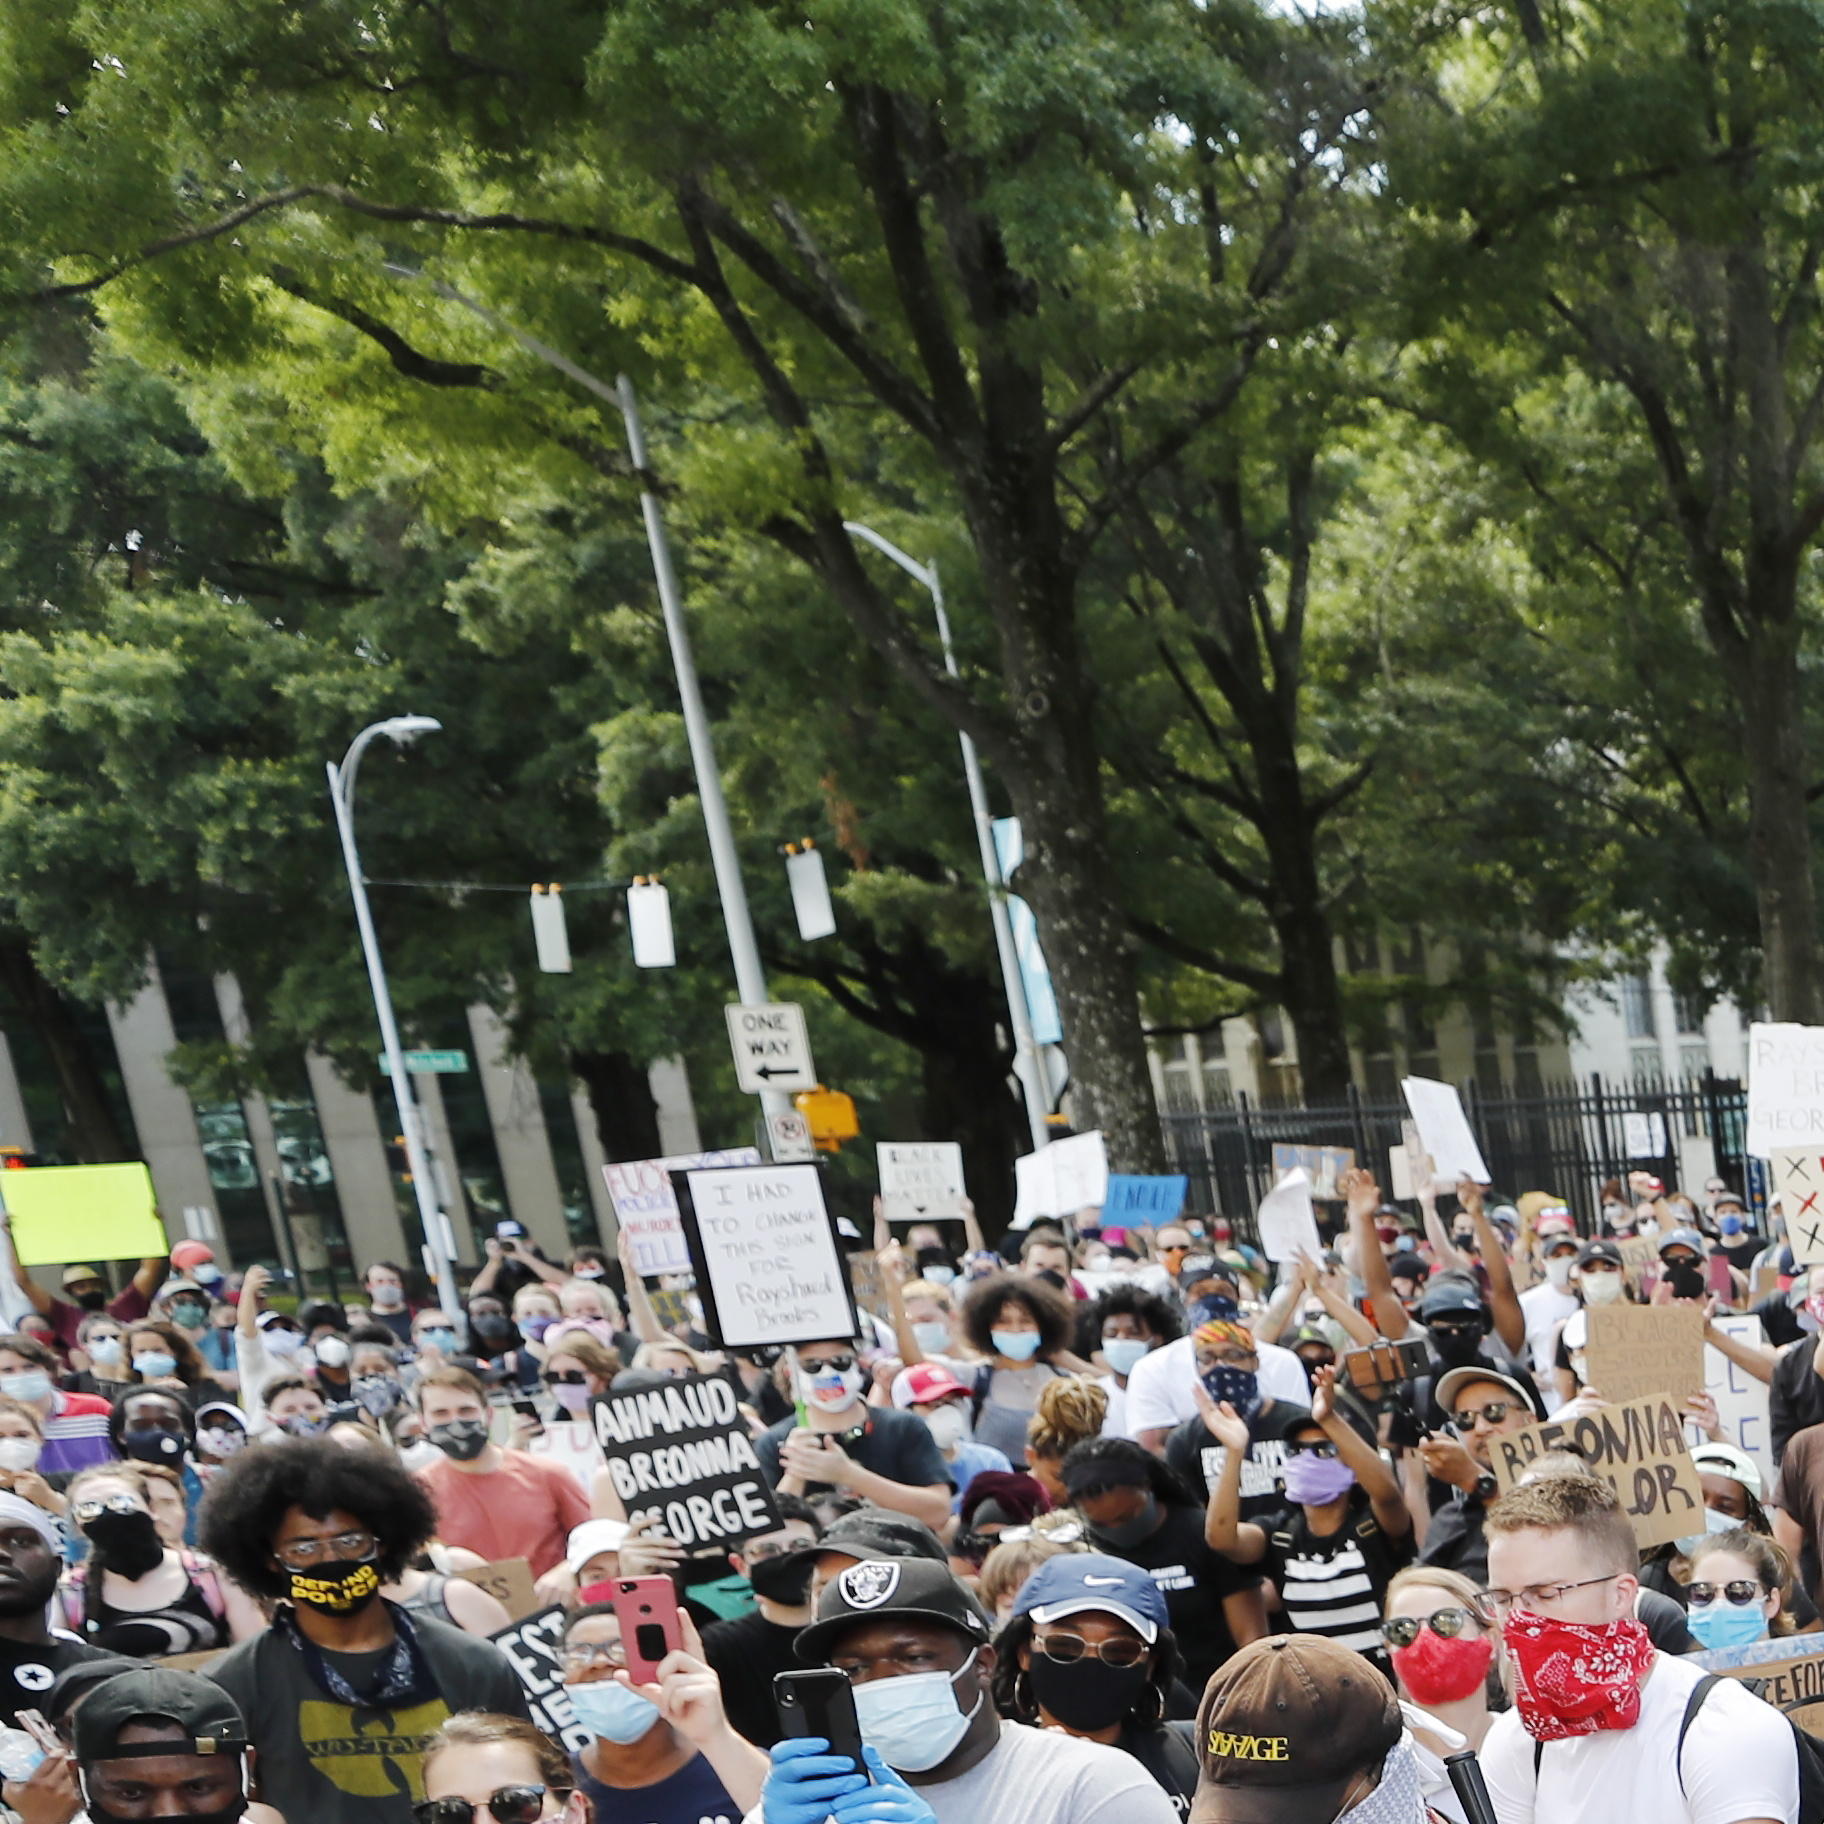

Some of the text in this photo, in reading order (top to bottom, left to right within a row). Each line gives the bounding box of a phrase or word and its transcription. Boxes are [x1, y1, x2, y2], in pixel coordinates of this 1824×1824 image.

[742, 1013, 789, 1032] ONE
[747, 1040, 792, 1056] WAY
[713, 1183, 793, 1205] I HAD
[703, 1216, 739, 1234] TO
[722, 1240, 764, 1258] THIS
[748, 1256, 795, 1275] FOR
[594, 1378, 738, 1448] AHMAUD
[608, 1430, 761, 1500] BREONNA
